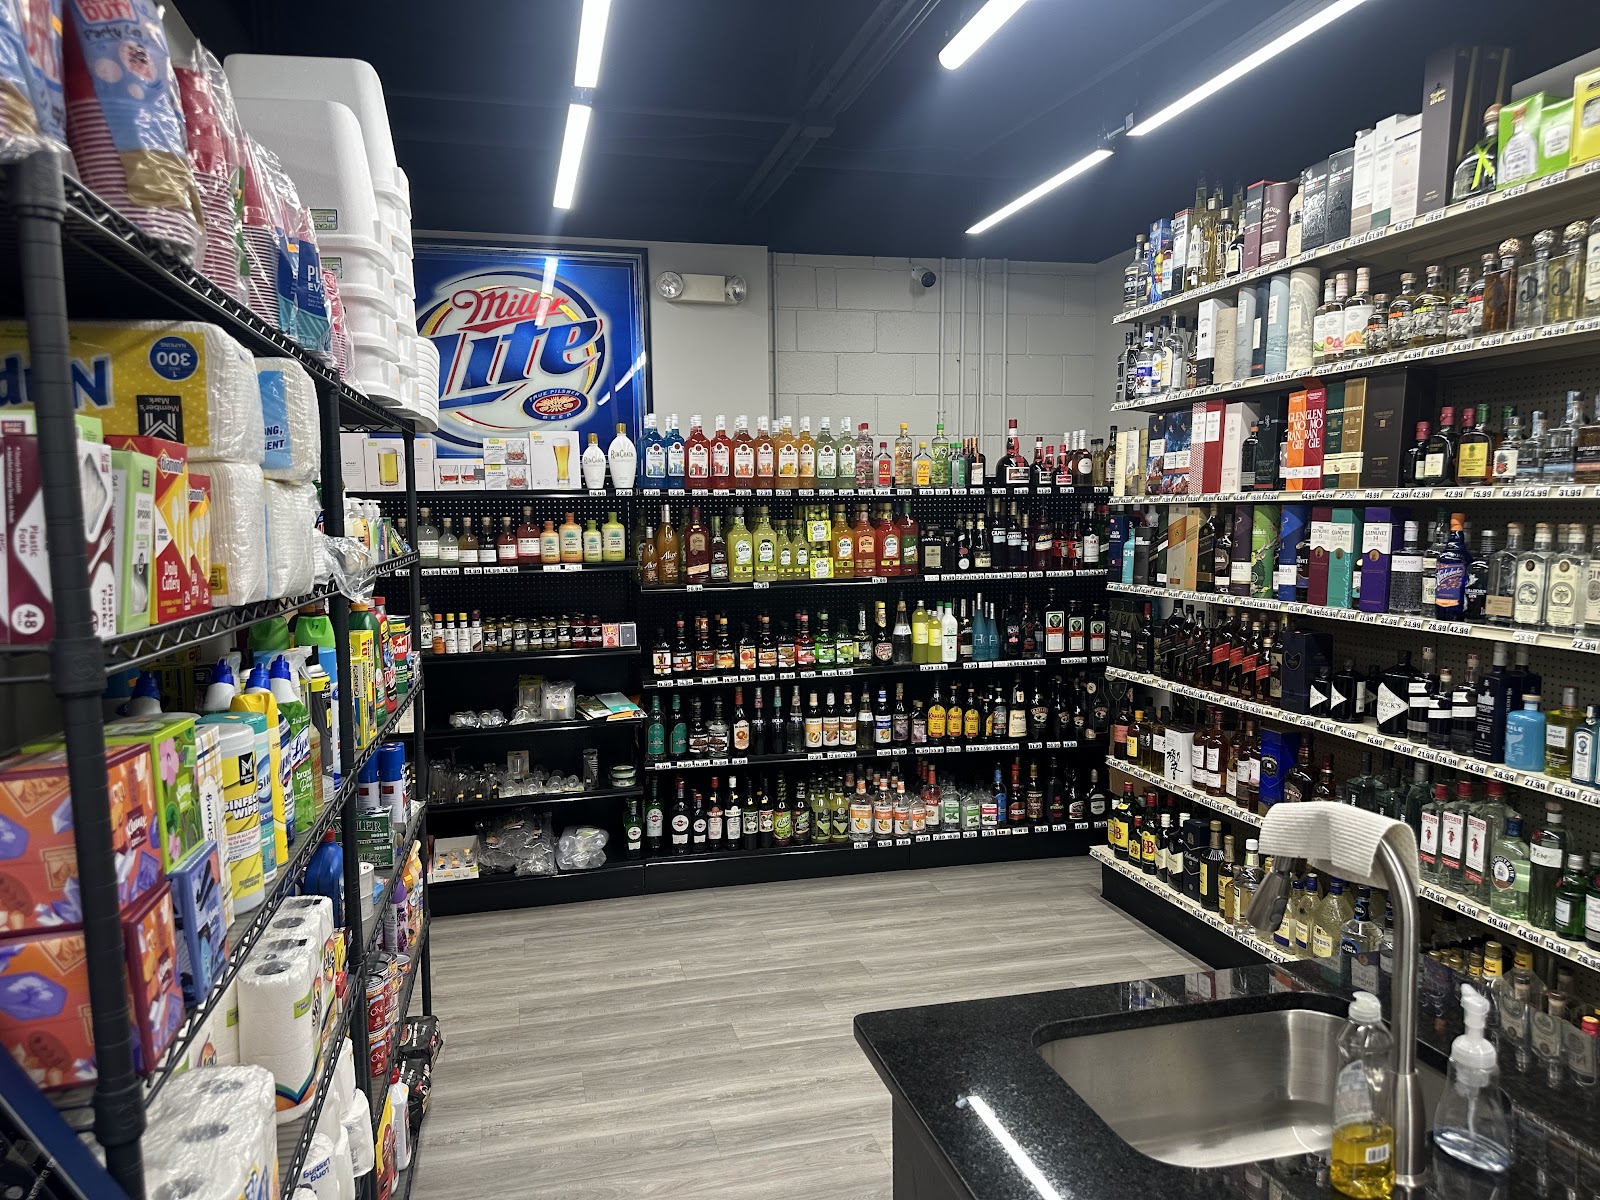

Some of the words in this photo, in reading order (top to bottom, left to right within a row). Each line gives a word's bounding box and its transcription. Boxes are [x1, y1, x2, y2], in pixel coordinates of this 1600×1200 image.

[83, 4, 134, 21] DUTY
[156, 351, 192, 367] 300
[427, 319, 603, 408] Lite
[529, 390, 548, 403] TRUE
[550, 387, 581, 398] PILSNER
[541, 412, 573, 421] BEER
[1288, 411, 1306, 421] GLEN
[1305, 409, 1323, 420] GLEN
[1294, 420, 1306, 430] MO
[1310, 419, 1324, 429] MO
[1288, 430, 1301, 441] RAN
[1304, 429, 1318, 440] RAN
[1292, 440, 1304, 450] GIE
[1308, 438, 1321, 448] GIE
[900, 446, 912, 458] 99
[934, 446, 948, 459] 99
[160, 458, 186, 474] diamond
[189, 488, 206, 501] amond
[1391, 491, 1409, 499] 22.99
[1444, 490, 1463, 498] 42.99
[1472, 490, 1492, 498] 15.99
[1502, 490, 1522, 498] 12.99
[1525, 489, 1548, 497] 25.99
[1558, 489, 1582, 497] 31.99
[18, 528, 28, 554] Forks
[29, 525, 39, 558] Plastic
[164, 561, 179, 578] Daily
[162, 574, 182, 593] Cutlery
[25, 609, 38, 629] 48
[1403, 620, 1421, 628] 33.99
[1449, 626, 1469, 635] 42.99
[1572, 641, 1596, 651] 22.99
[1437, 753, 1457, 766] 39.99
[1464, 762, 1485, 774] 34.99
[1493, 770, 1515, 782] 38.99
[1524, 778, 1546, 790] 27.99
[1554, 786, 1576, 798] 13.99
[206, 792, 214, 842] Strong
[1442, 812, 1462, 825] BEEFEATER
[1468, 818, 1486, 831] BEEFEATER
[1456, 903, 1477, 917] 43.99
[1487, 916, 1509, 930] 39.99
[1517, 928, 1539, 943] 44.99
[1545, 939, 1567, 954] 13.99
[369, 1005, 384, 1017] ONE
[370, 1051, 385, 1063] ONE
[302, 1157, 331, 1179] Lasting
[310, 1167, 330, 1183] Long
